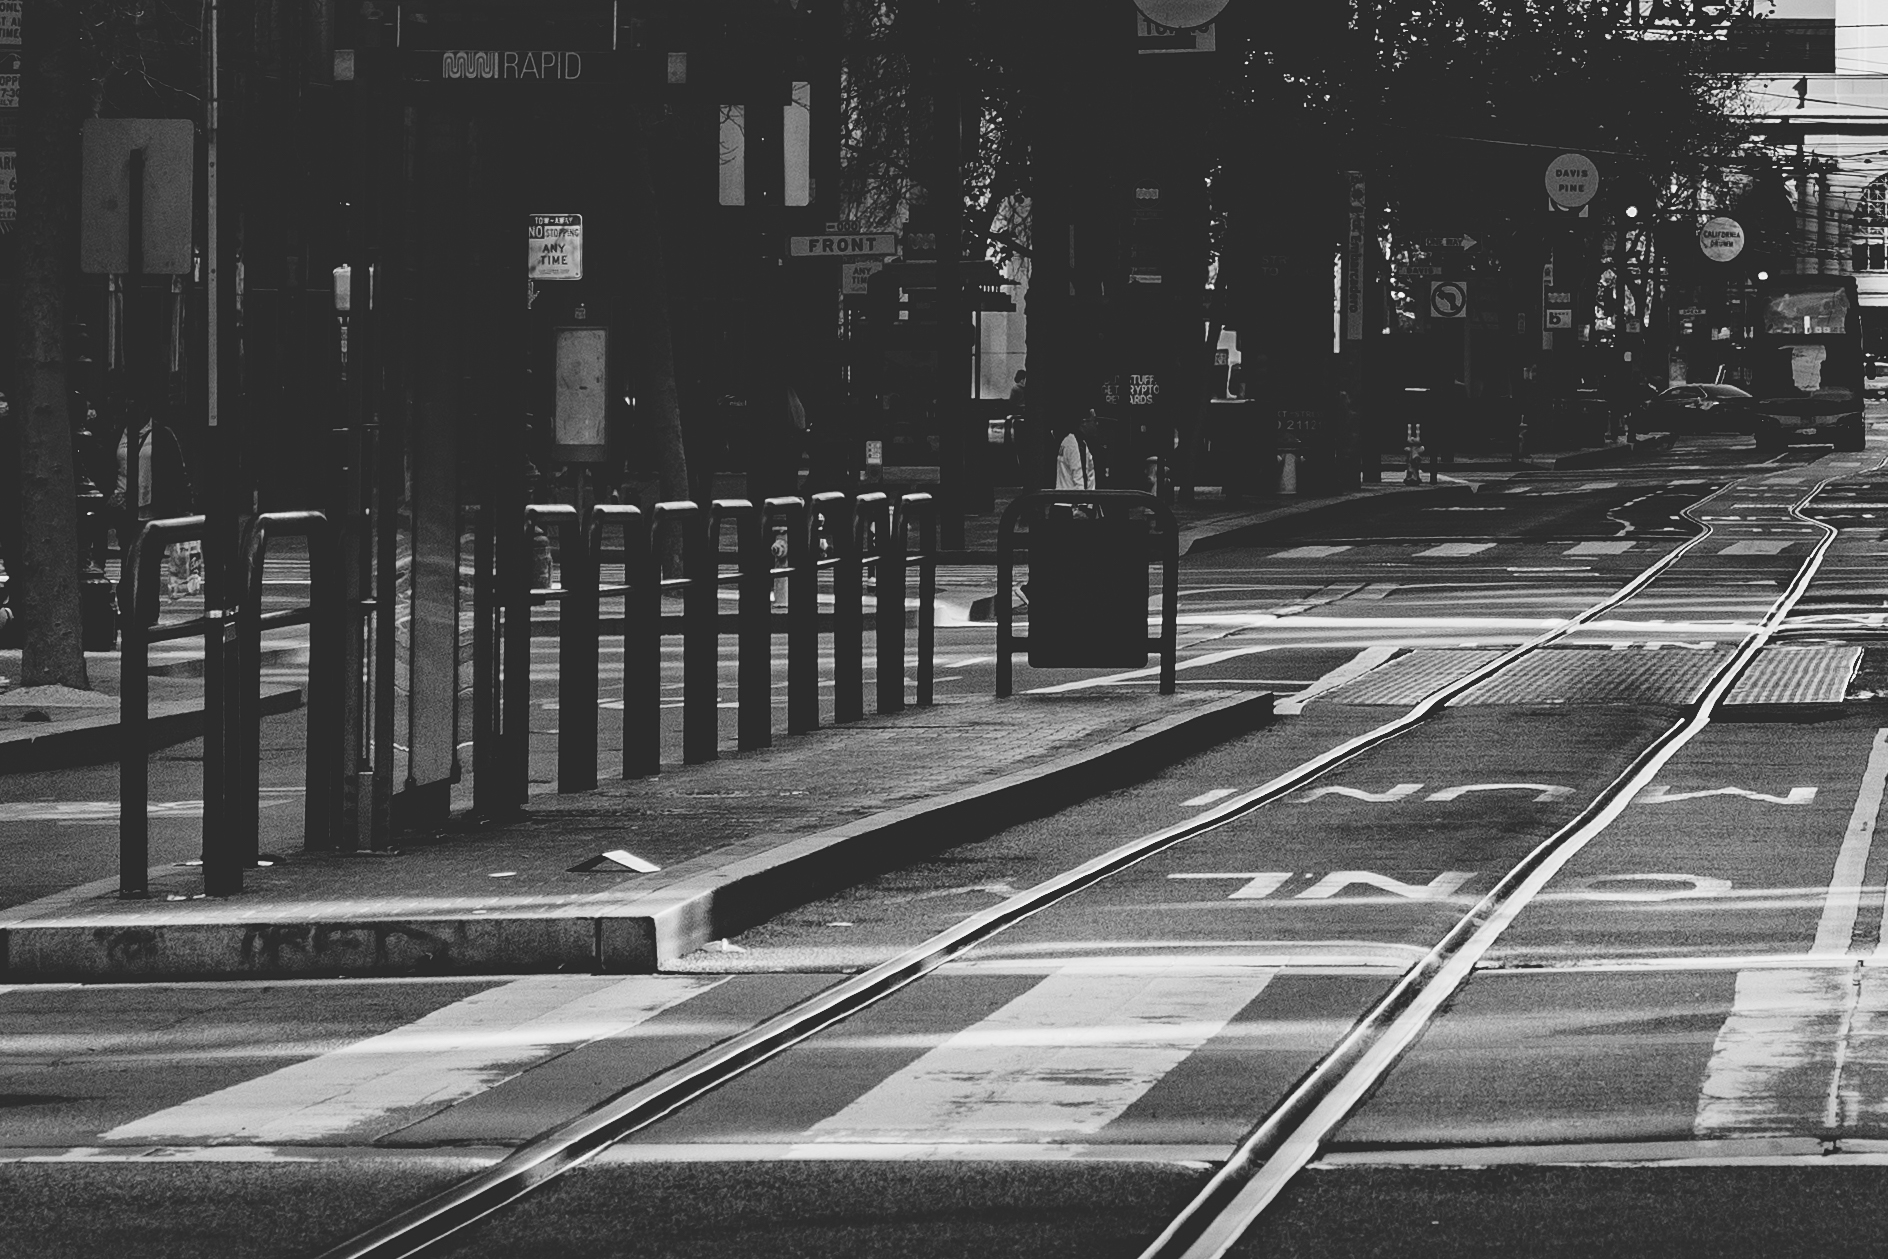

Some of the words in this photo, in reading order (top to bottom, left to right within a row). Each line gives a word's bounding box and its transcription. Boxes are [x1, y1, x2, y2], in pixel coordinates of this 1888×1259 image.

[503, 51, 582, 80] RAPID
[1555, 169, 1589, 178] DAVIS
[1558, 184, 1585, 193] PINE
[529, 225, 544, 238] NO
[546, 228, 579, 238] STOPPING
[542, 243, 566, 254] ANY
[808, 237, 877, 253] FRONT
[540, 255, 568, 266] TIME
[852, 267, 872, 276] ANY
[852, 276, 869, 285] TIM
[1129, 384, 1160, 395] RYPTO
